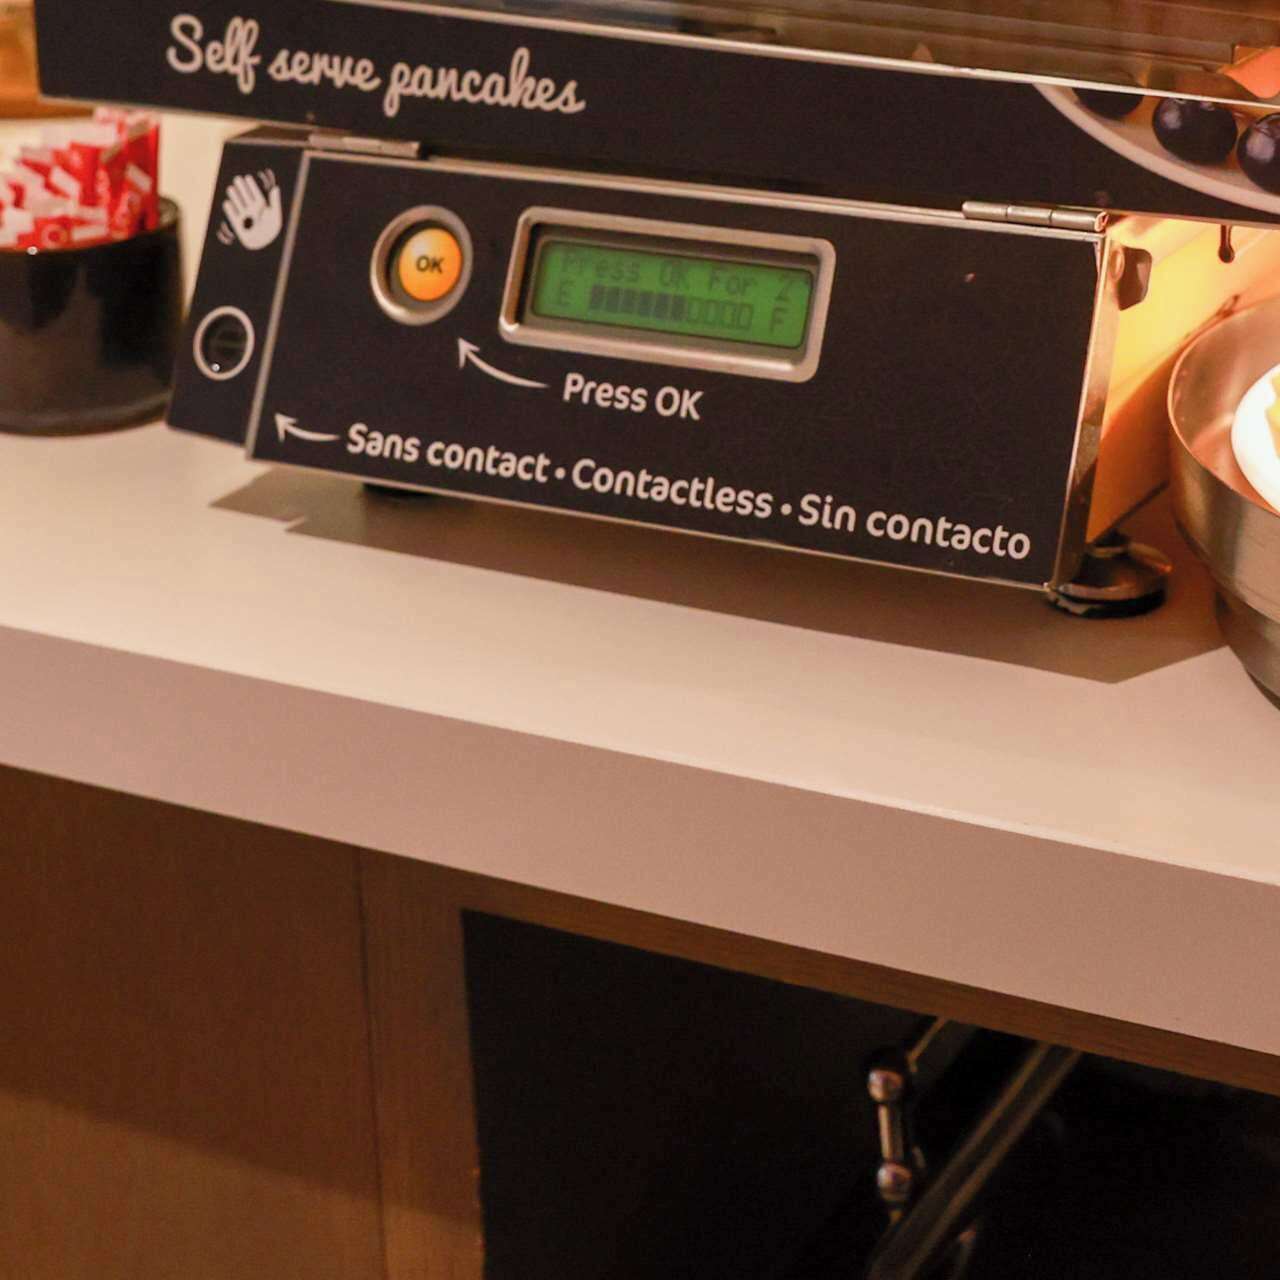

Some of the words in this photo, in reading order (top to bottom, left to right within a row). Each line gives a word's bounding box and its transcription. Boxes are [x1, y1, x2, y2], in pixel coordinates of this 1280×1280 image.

[166, 13, 261, 95] Self
[267, 48, 381, 92] serve
[382, 46, 587, 118] pancakes
[416, 256, 445, 274] OK
[659, 259, 691, 290] OK
[562, 372, 648, 413] Press
[654, 386, 705, 420] OK
[346, 422, 421, 464] Sans
[425, 441, 552, 484] contact
[571, 457, 774, 520] Contactless
[797, 492, 857, 533] Sin
[865, 510, 1032, 561] contacto
